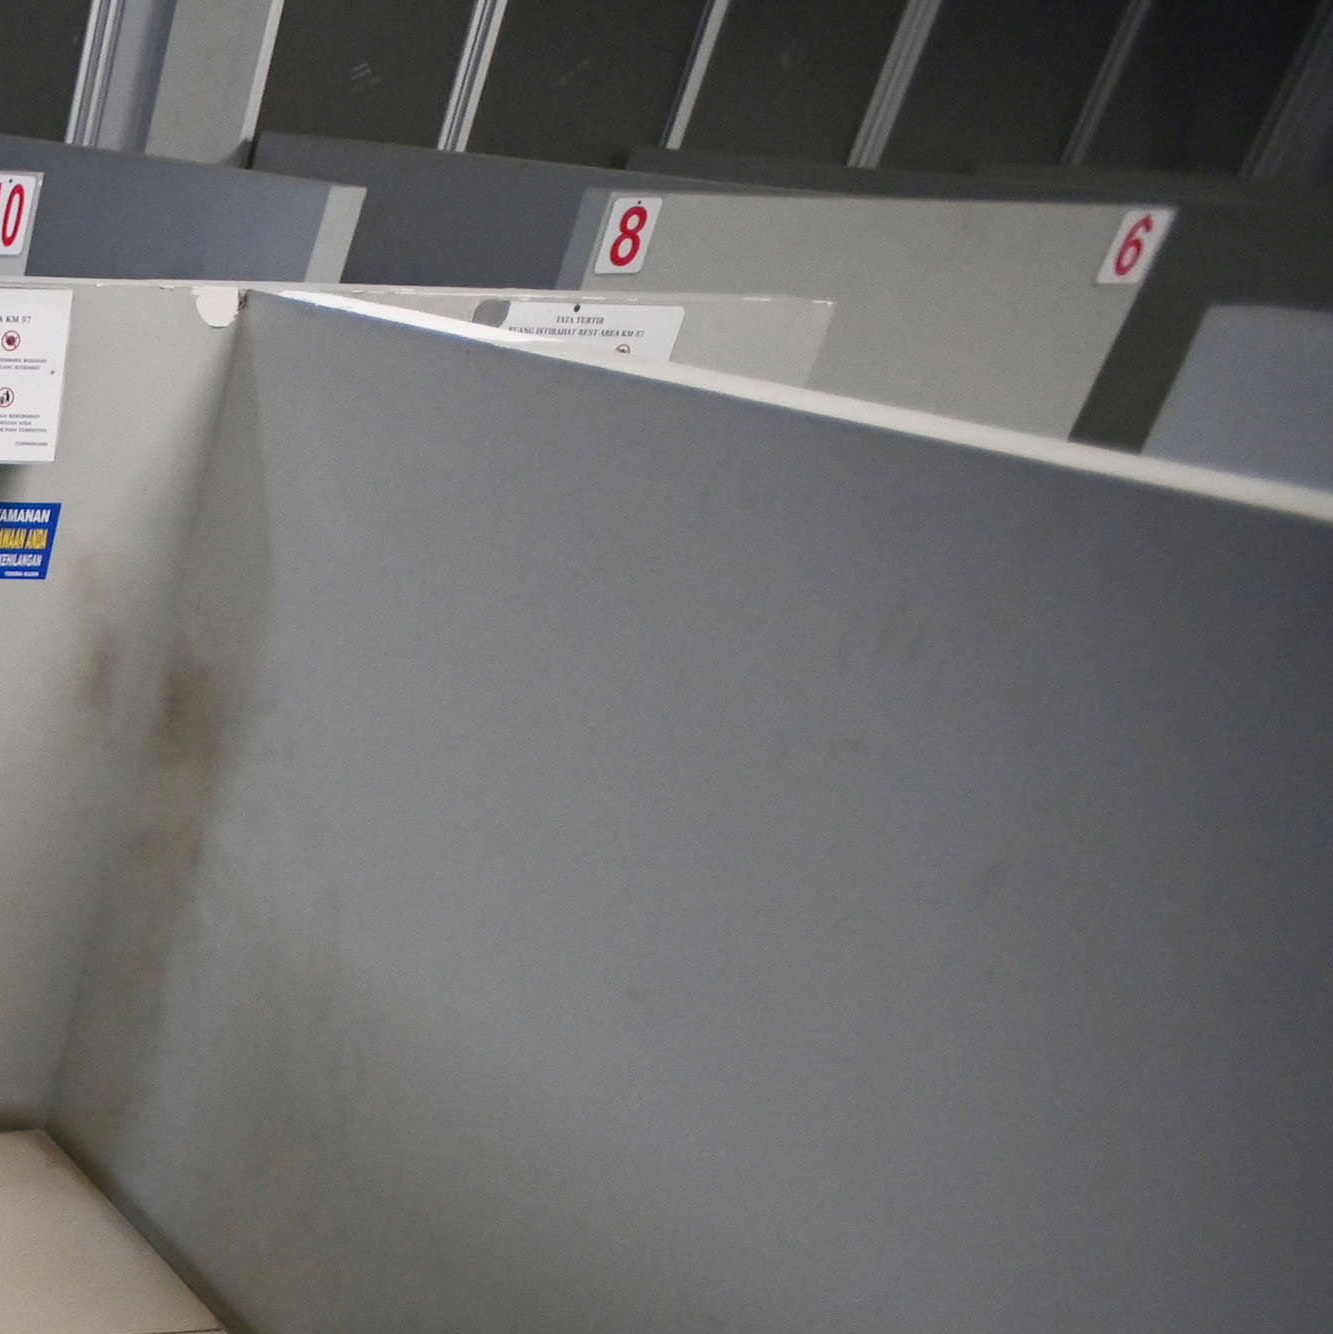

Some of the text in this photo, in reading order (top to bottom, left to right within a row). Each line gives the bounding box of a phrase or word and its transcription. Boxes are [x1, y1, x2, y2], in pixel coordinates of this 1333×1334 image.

[610, 206, 648, 267] 8
[1115, 214, 1154, 276] 6
[5, 314, 19, 323] KM
[21, 315, 32, 323] 57
[556, 315, 605, 325] TATA TERTIB
[535, 326, 577, 336] ISTIRAHAT
[578, 328, 598, 337] REST
[600, 328, 620, 337] AREA
[621, 329, 634, 337] KM
[25, 528, 48, 550] ANDA
